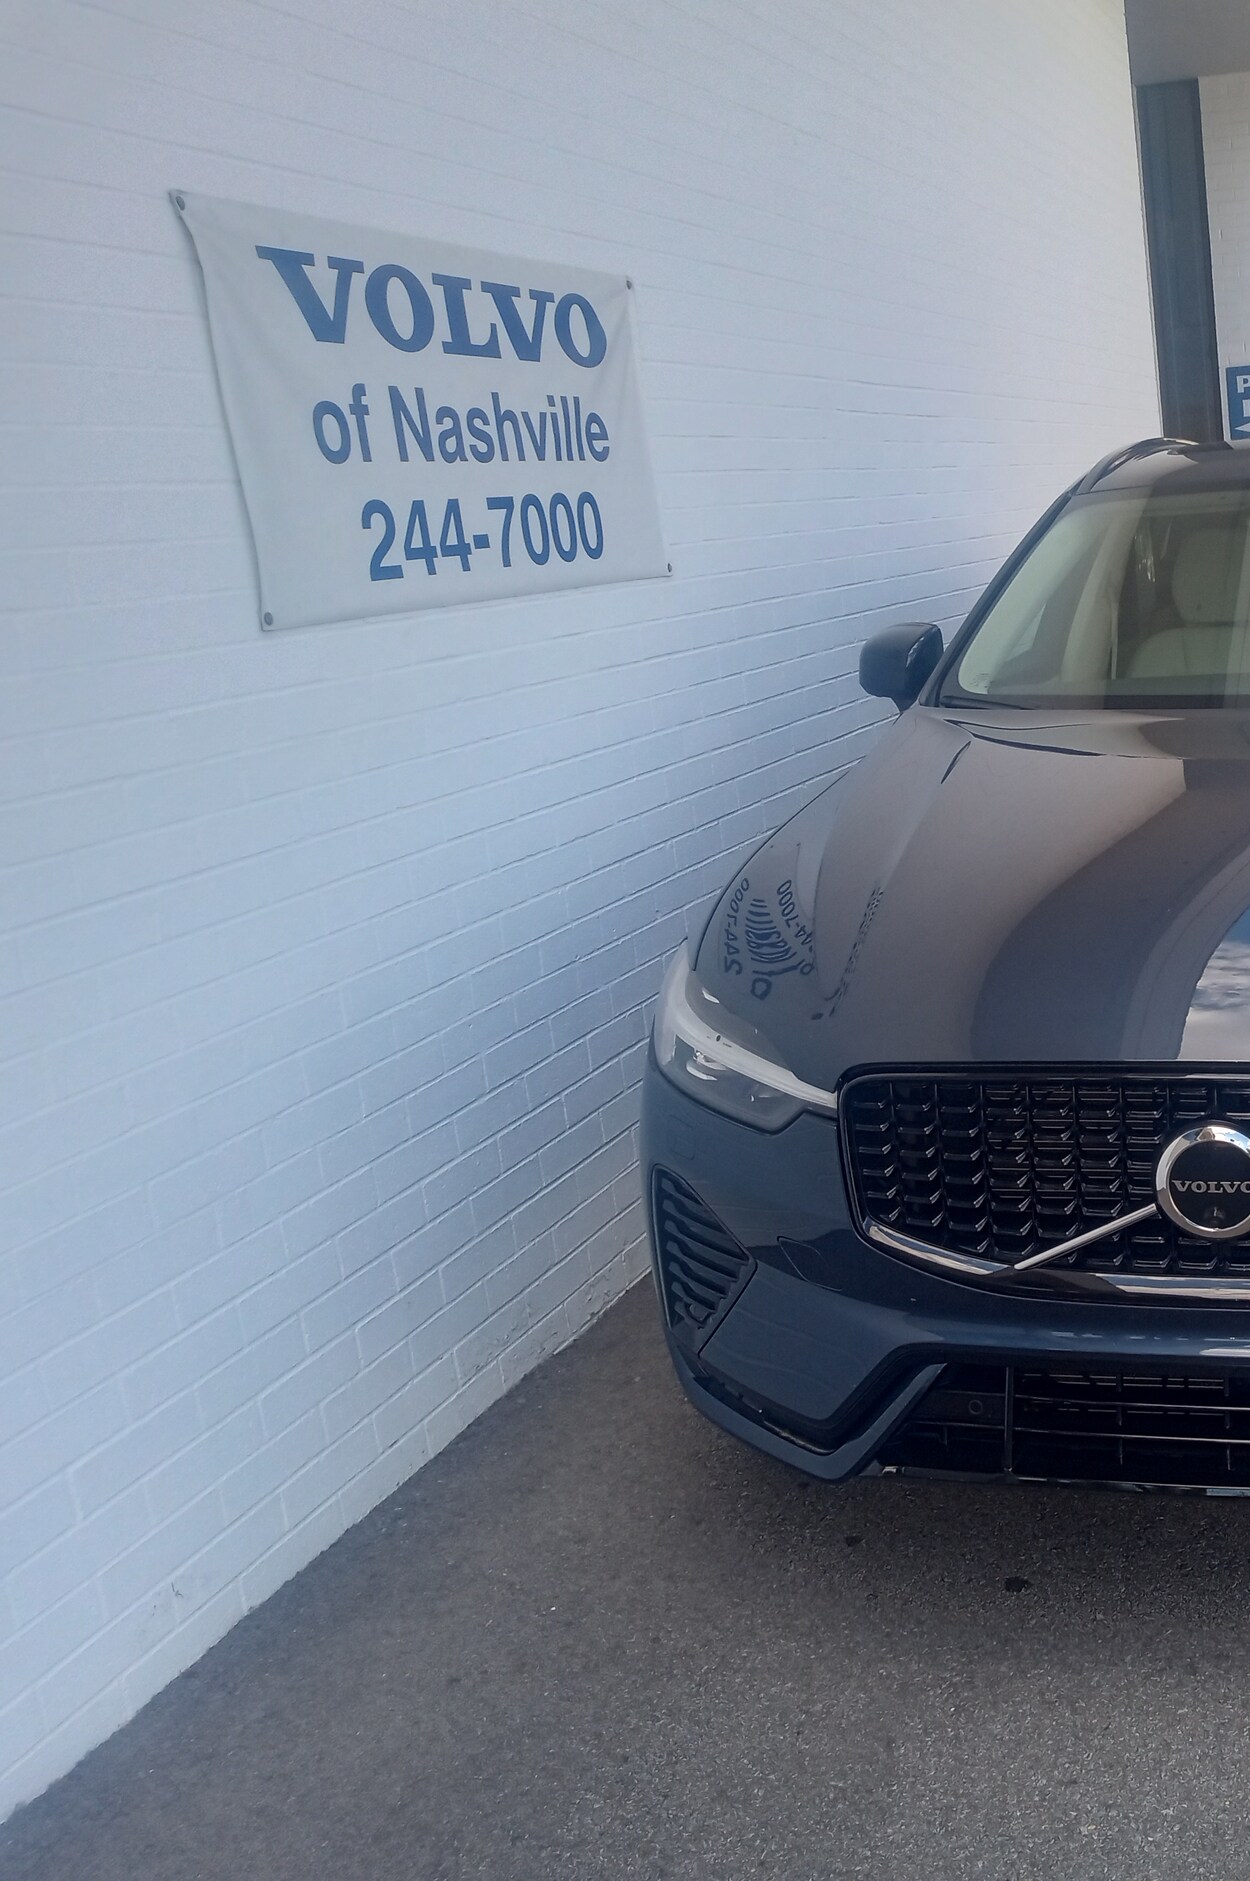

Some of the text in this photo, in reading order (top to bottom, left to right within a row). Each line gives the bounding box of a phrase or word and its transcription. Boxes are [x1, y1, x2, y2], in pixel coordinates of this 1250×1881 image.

[255, 245, 607, 369] VOLVO
[312, 383, 610, 465] of Nashville
[361, 491, 604, 582] 244-7000
